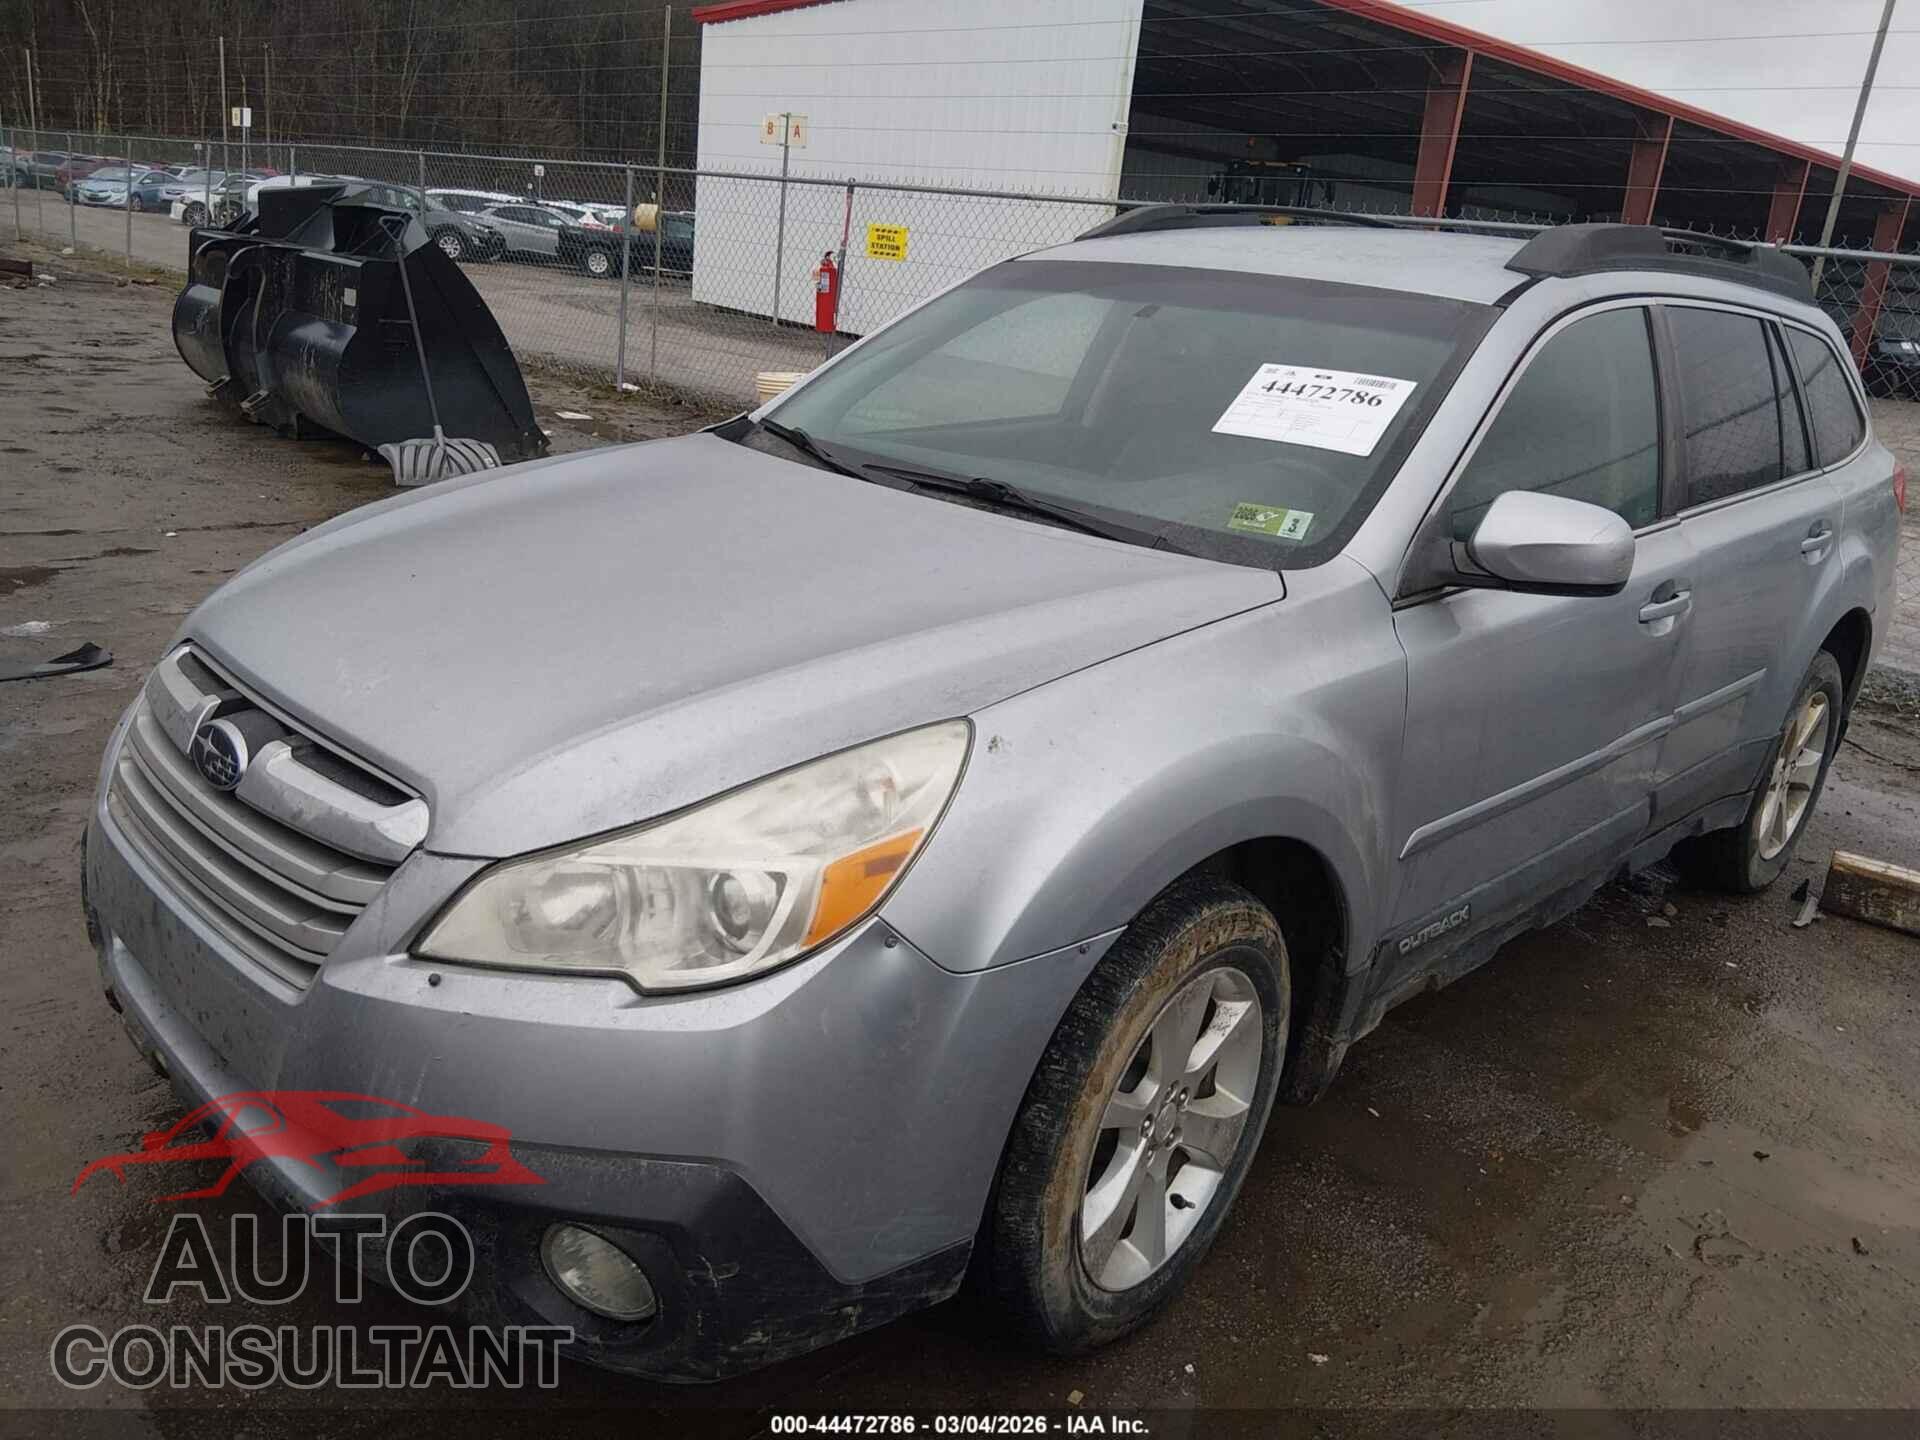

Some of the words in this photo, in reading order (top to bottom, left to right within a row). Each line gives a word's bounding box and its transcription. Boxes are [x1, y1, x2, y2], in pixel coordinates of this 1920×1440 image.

[767, 121, 774, 136] B
[793, 124, 801, 138] A
[876, 233, 896, 243] SPILL
[871, 242, 901, 251] STATION
[1261, 379, 1383, 408] 44472786
[1399, 904, 1469, 955] OUTBACK
